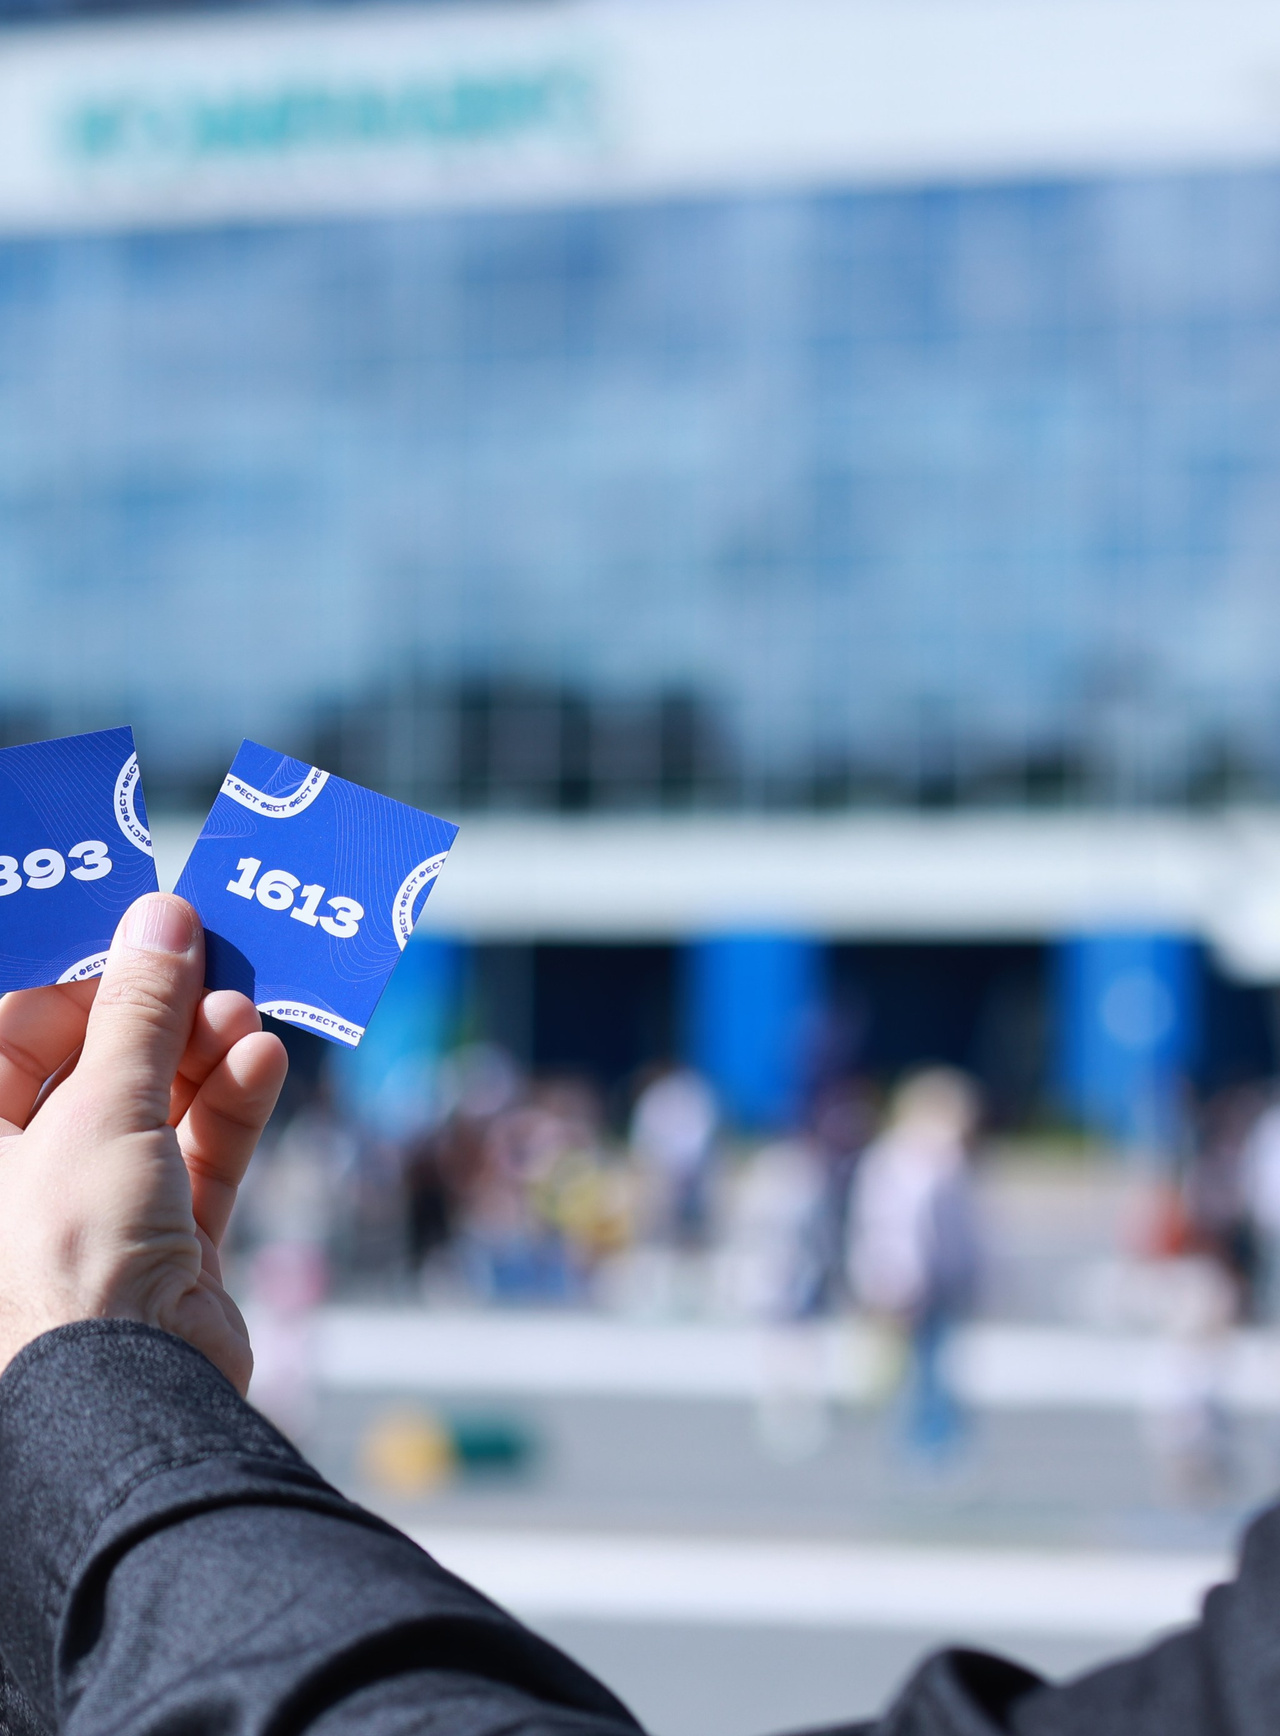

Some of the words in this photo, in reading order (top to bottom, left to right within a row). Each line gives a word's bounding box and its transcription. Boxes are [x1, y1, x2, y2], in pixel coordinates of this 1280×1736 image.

[234, 784, 259, 803] ФЕСТ
[260, 801, 287, 812] ФЕСТ
[288, 786, 312, 808] ФЕСТ
[311, 769, 322, 785] ФЕ
[119, 790, 131, 823] ФЕСТ
[127, 823, 152, 847] ФЕСТ
[225, 857, 365, 939] 1613
[400, 877, 418, 908] ФЕСТ
[399, 910, 411, 941] ФЕСТ
[79, 958, 108, 976] ФЕСТ
[276, 1008, 308, 1018] ФЕСТ
[309, 1013, 338, 1028] ФЕСТ
